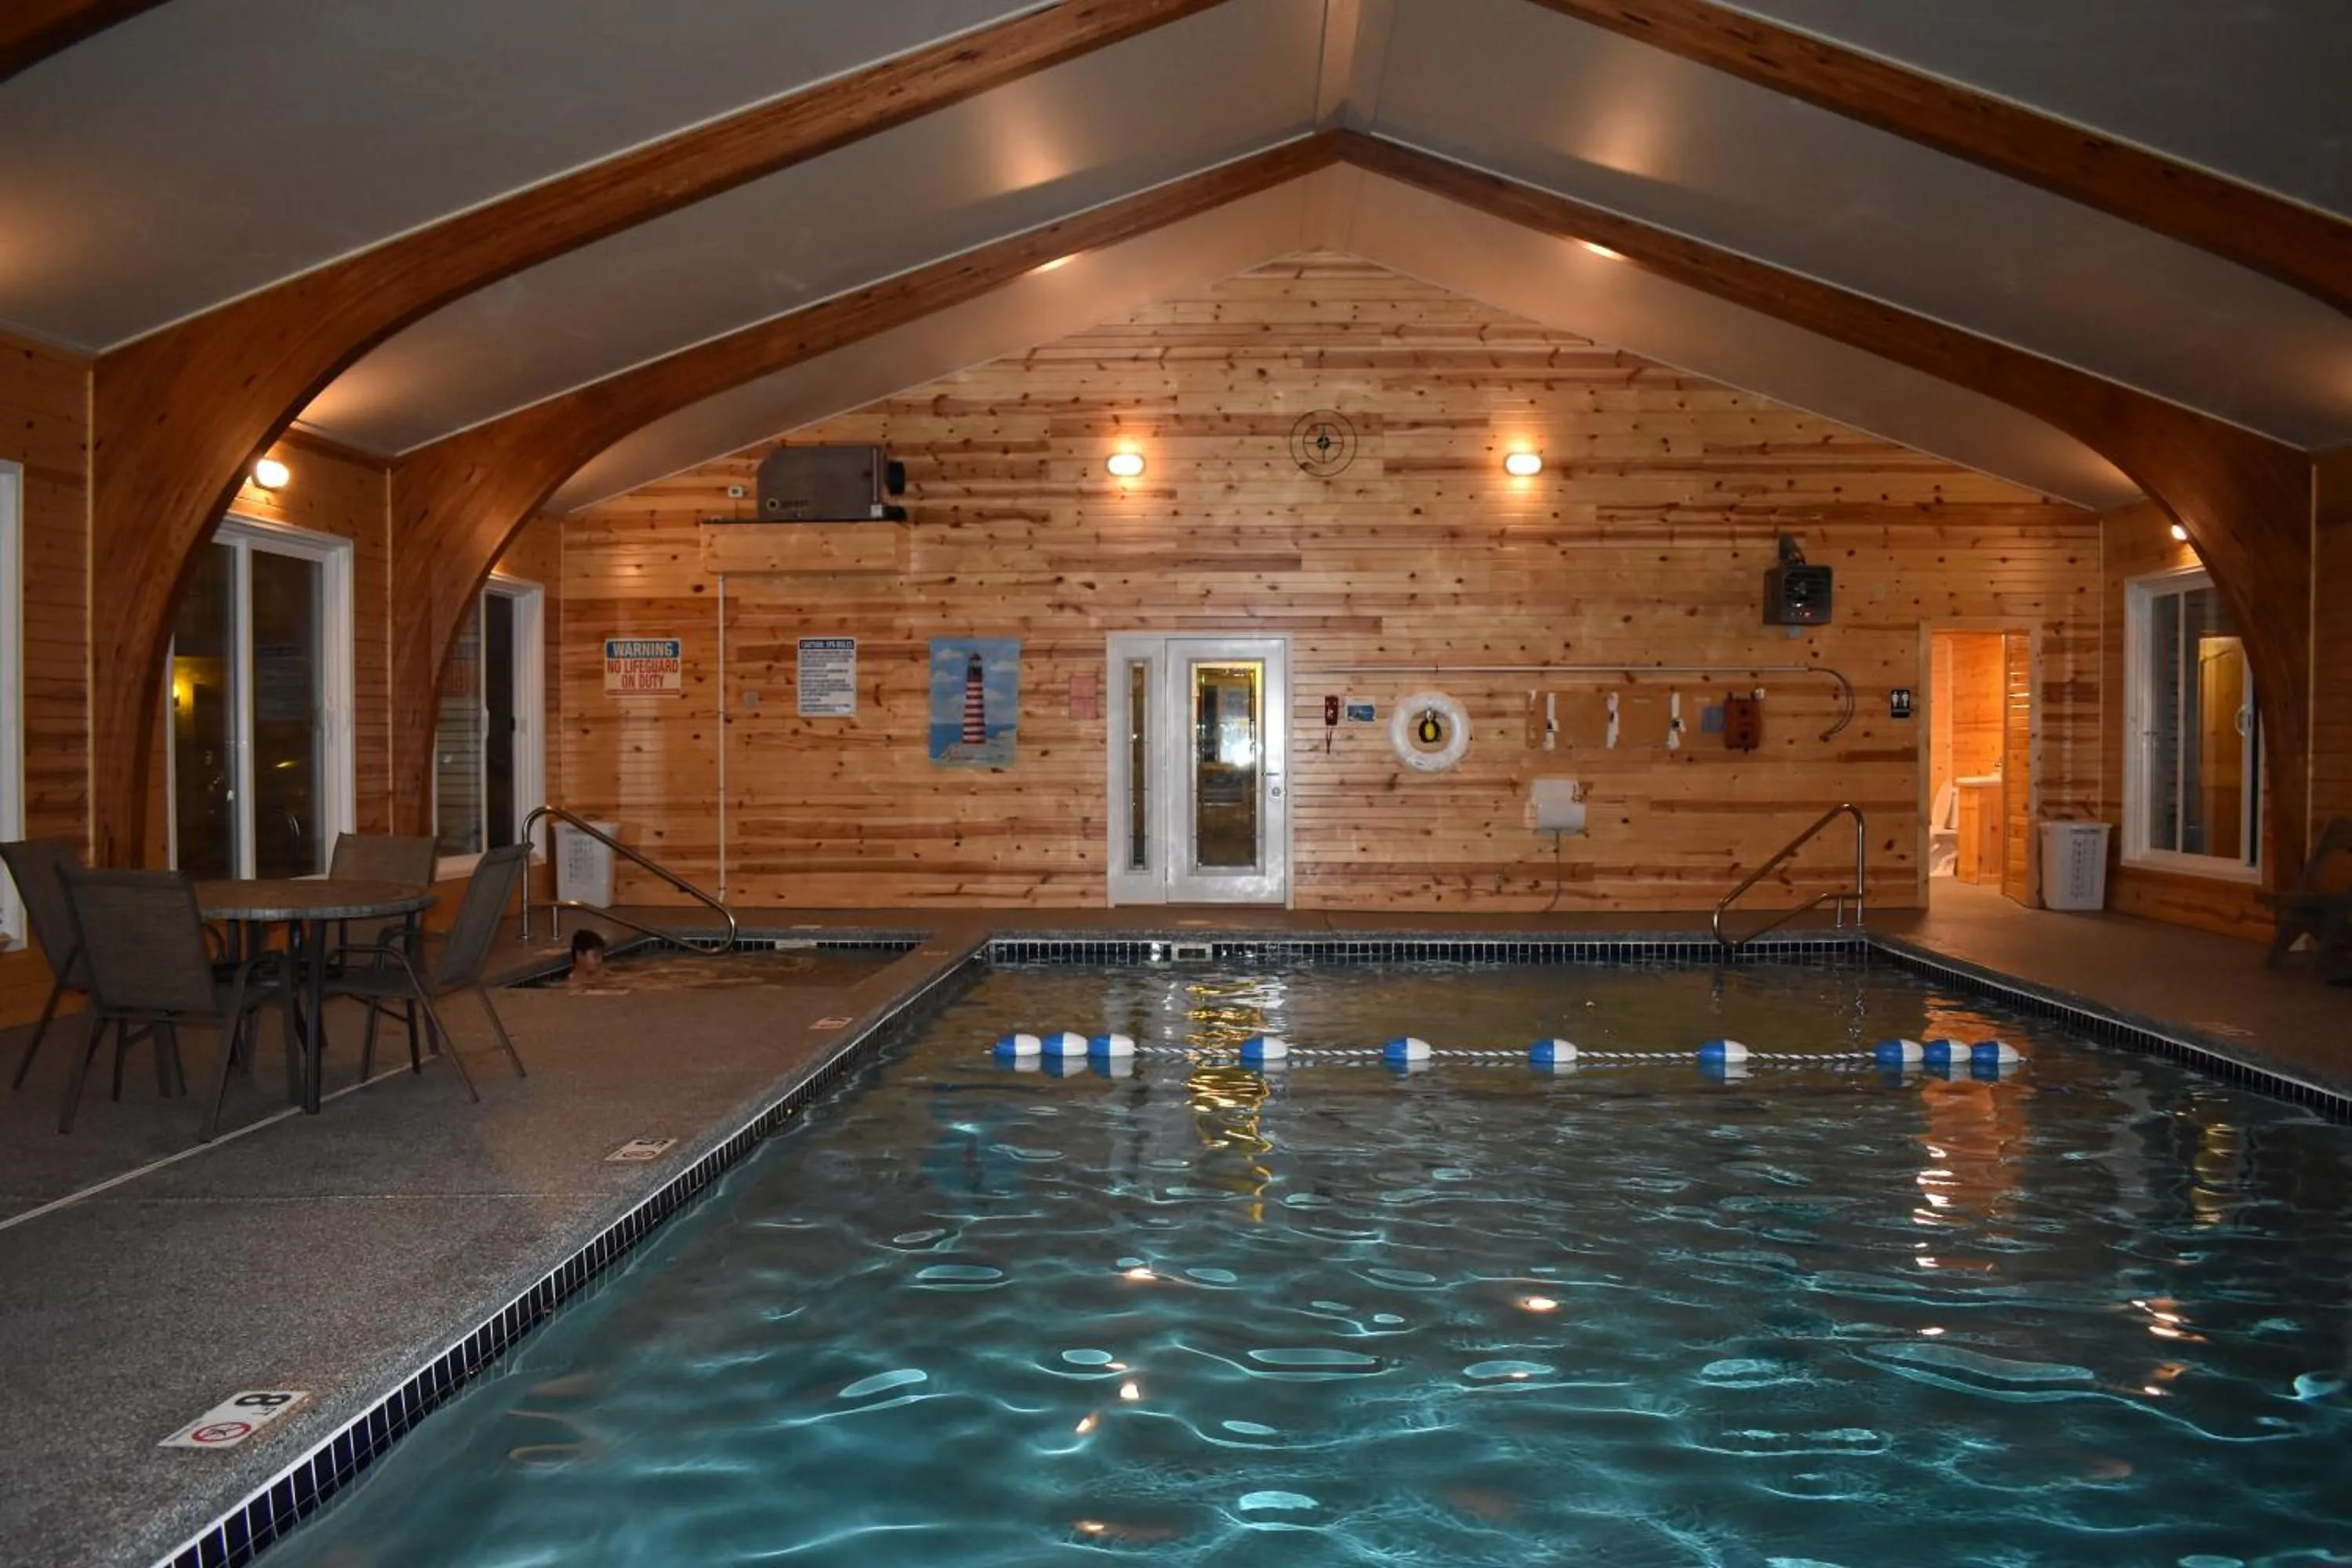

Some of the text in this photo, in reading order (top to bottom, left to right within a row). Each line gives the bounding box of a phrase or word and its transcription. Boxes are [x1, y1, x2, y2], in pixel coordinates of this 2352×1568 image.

[612, 642, 673, 656] WARNING
[608, 659, 677, 673] NO LIFEGUARD
[622, 674, 664, 688] ON DUTY
[234, 1393, 292, 1406] 8
